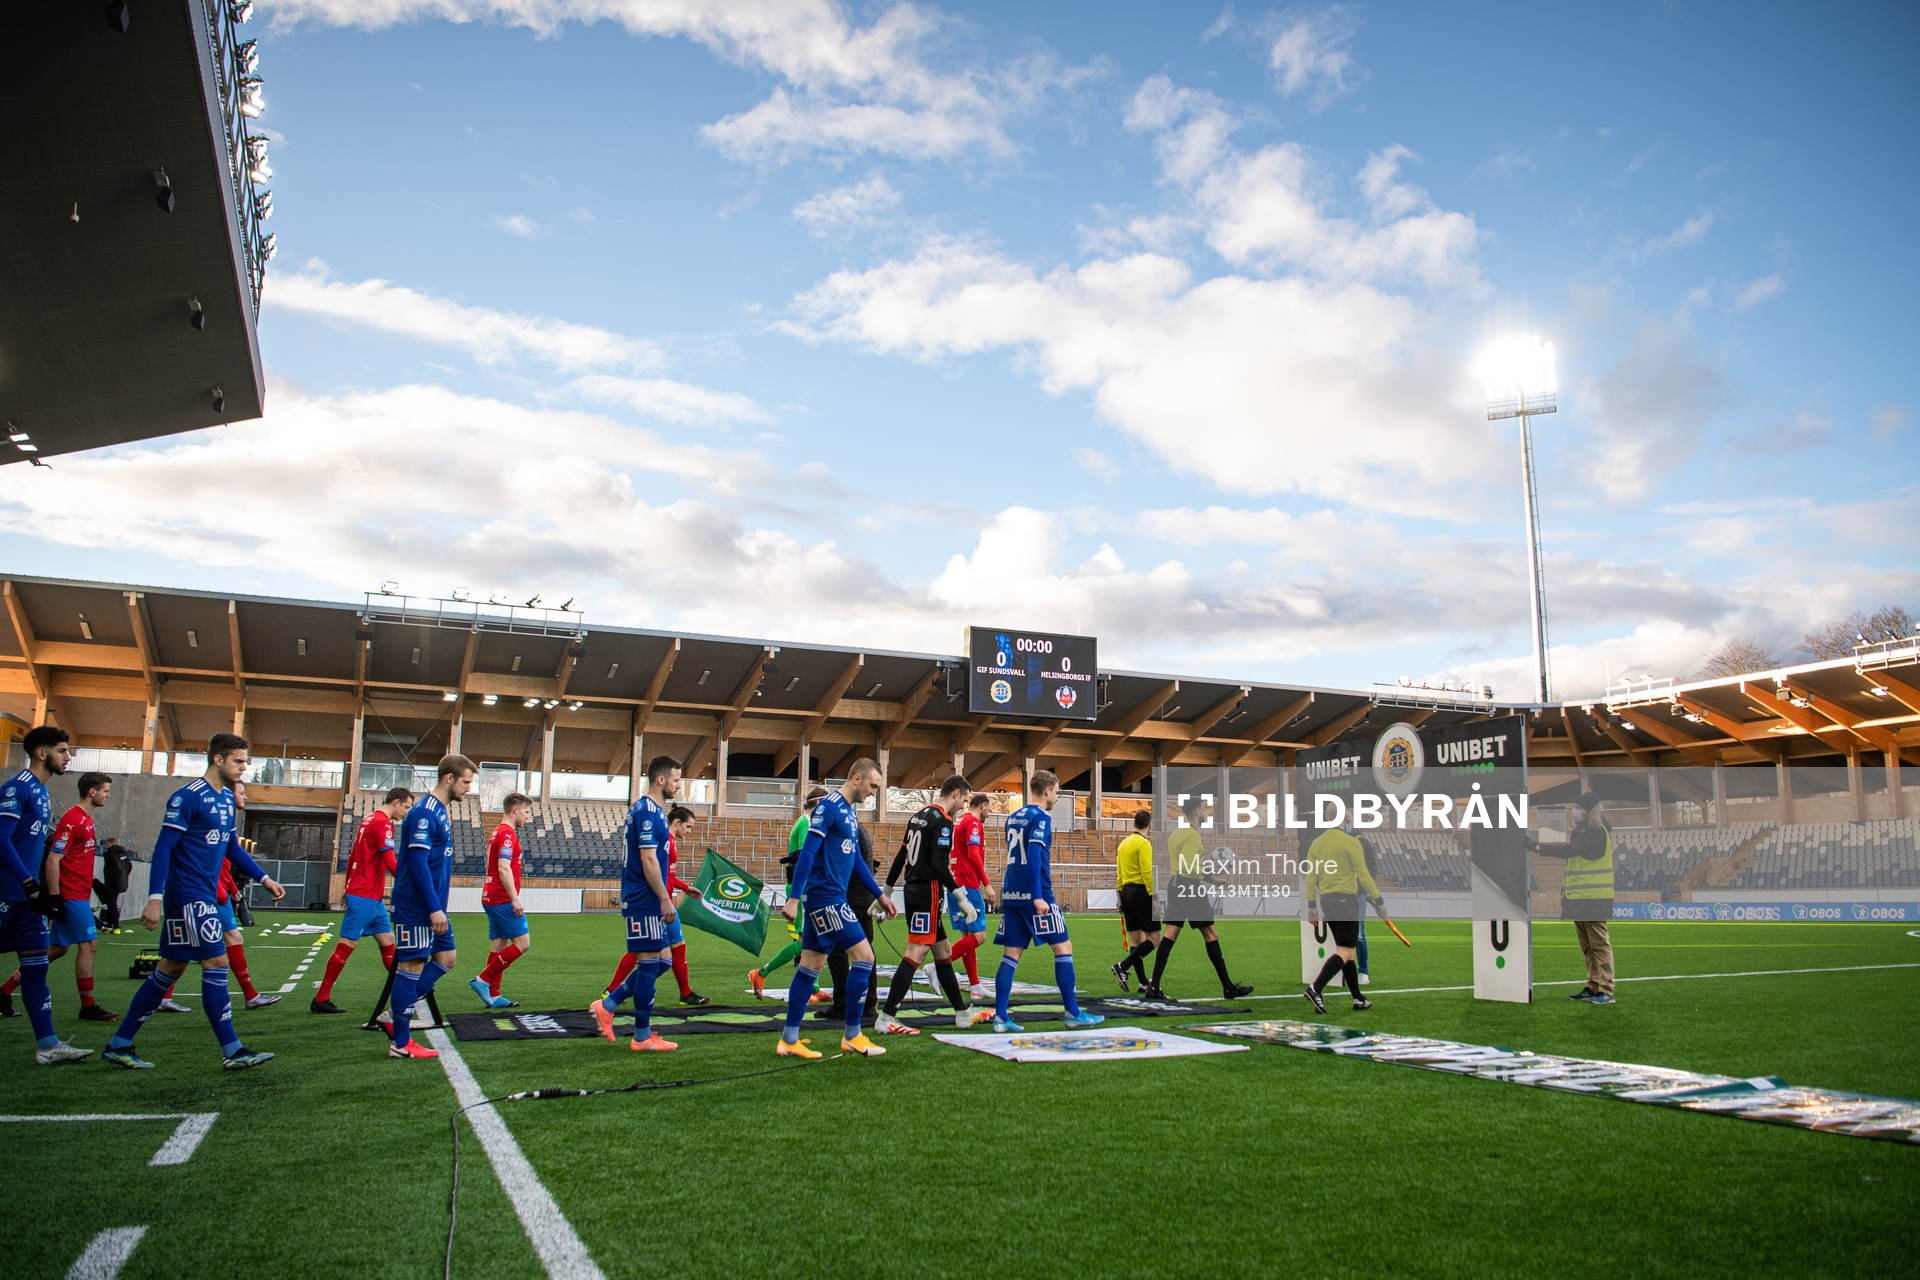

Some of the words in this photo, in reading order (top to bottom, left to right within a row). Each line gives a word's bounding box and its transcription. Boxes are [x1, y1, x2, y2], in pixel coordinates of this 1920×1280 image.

[1017, 639, 1053, 653] 00:00
[997, 652, 1006, 667] 0
[1062, 657, 1071, 672] 0
[989, 667, 1026, 676] SUNDSVALL
[1041, 671, 1084, 681] HELSINGBORGS
[1436, 735, 1507, 764] UNIBET
[1305, 756, 1361, 780] UNIBET
[1007, 827, 1028, 865] 21
[723, 878, 746, 896] S
[709, 896, 751, 911] SUPERETTAN
[1809, 907, 1841, 919] OBOS
[1871, 907, 1905, 919] OBOS
